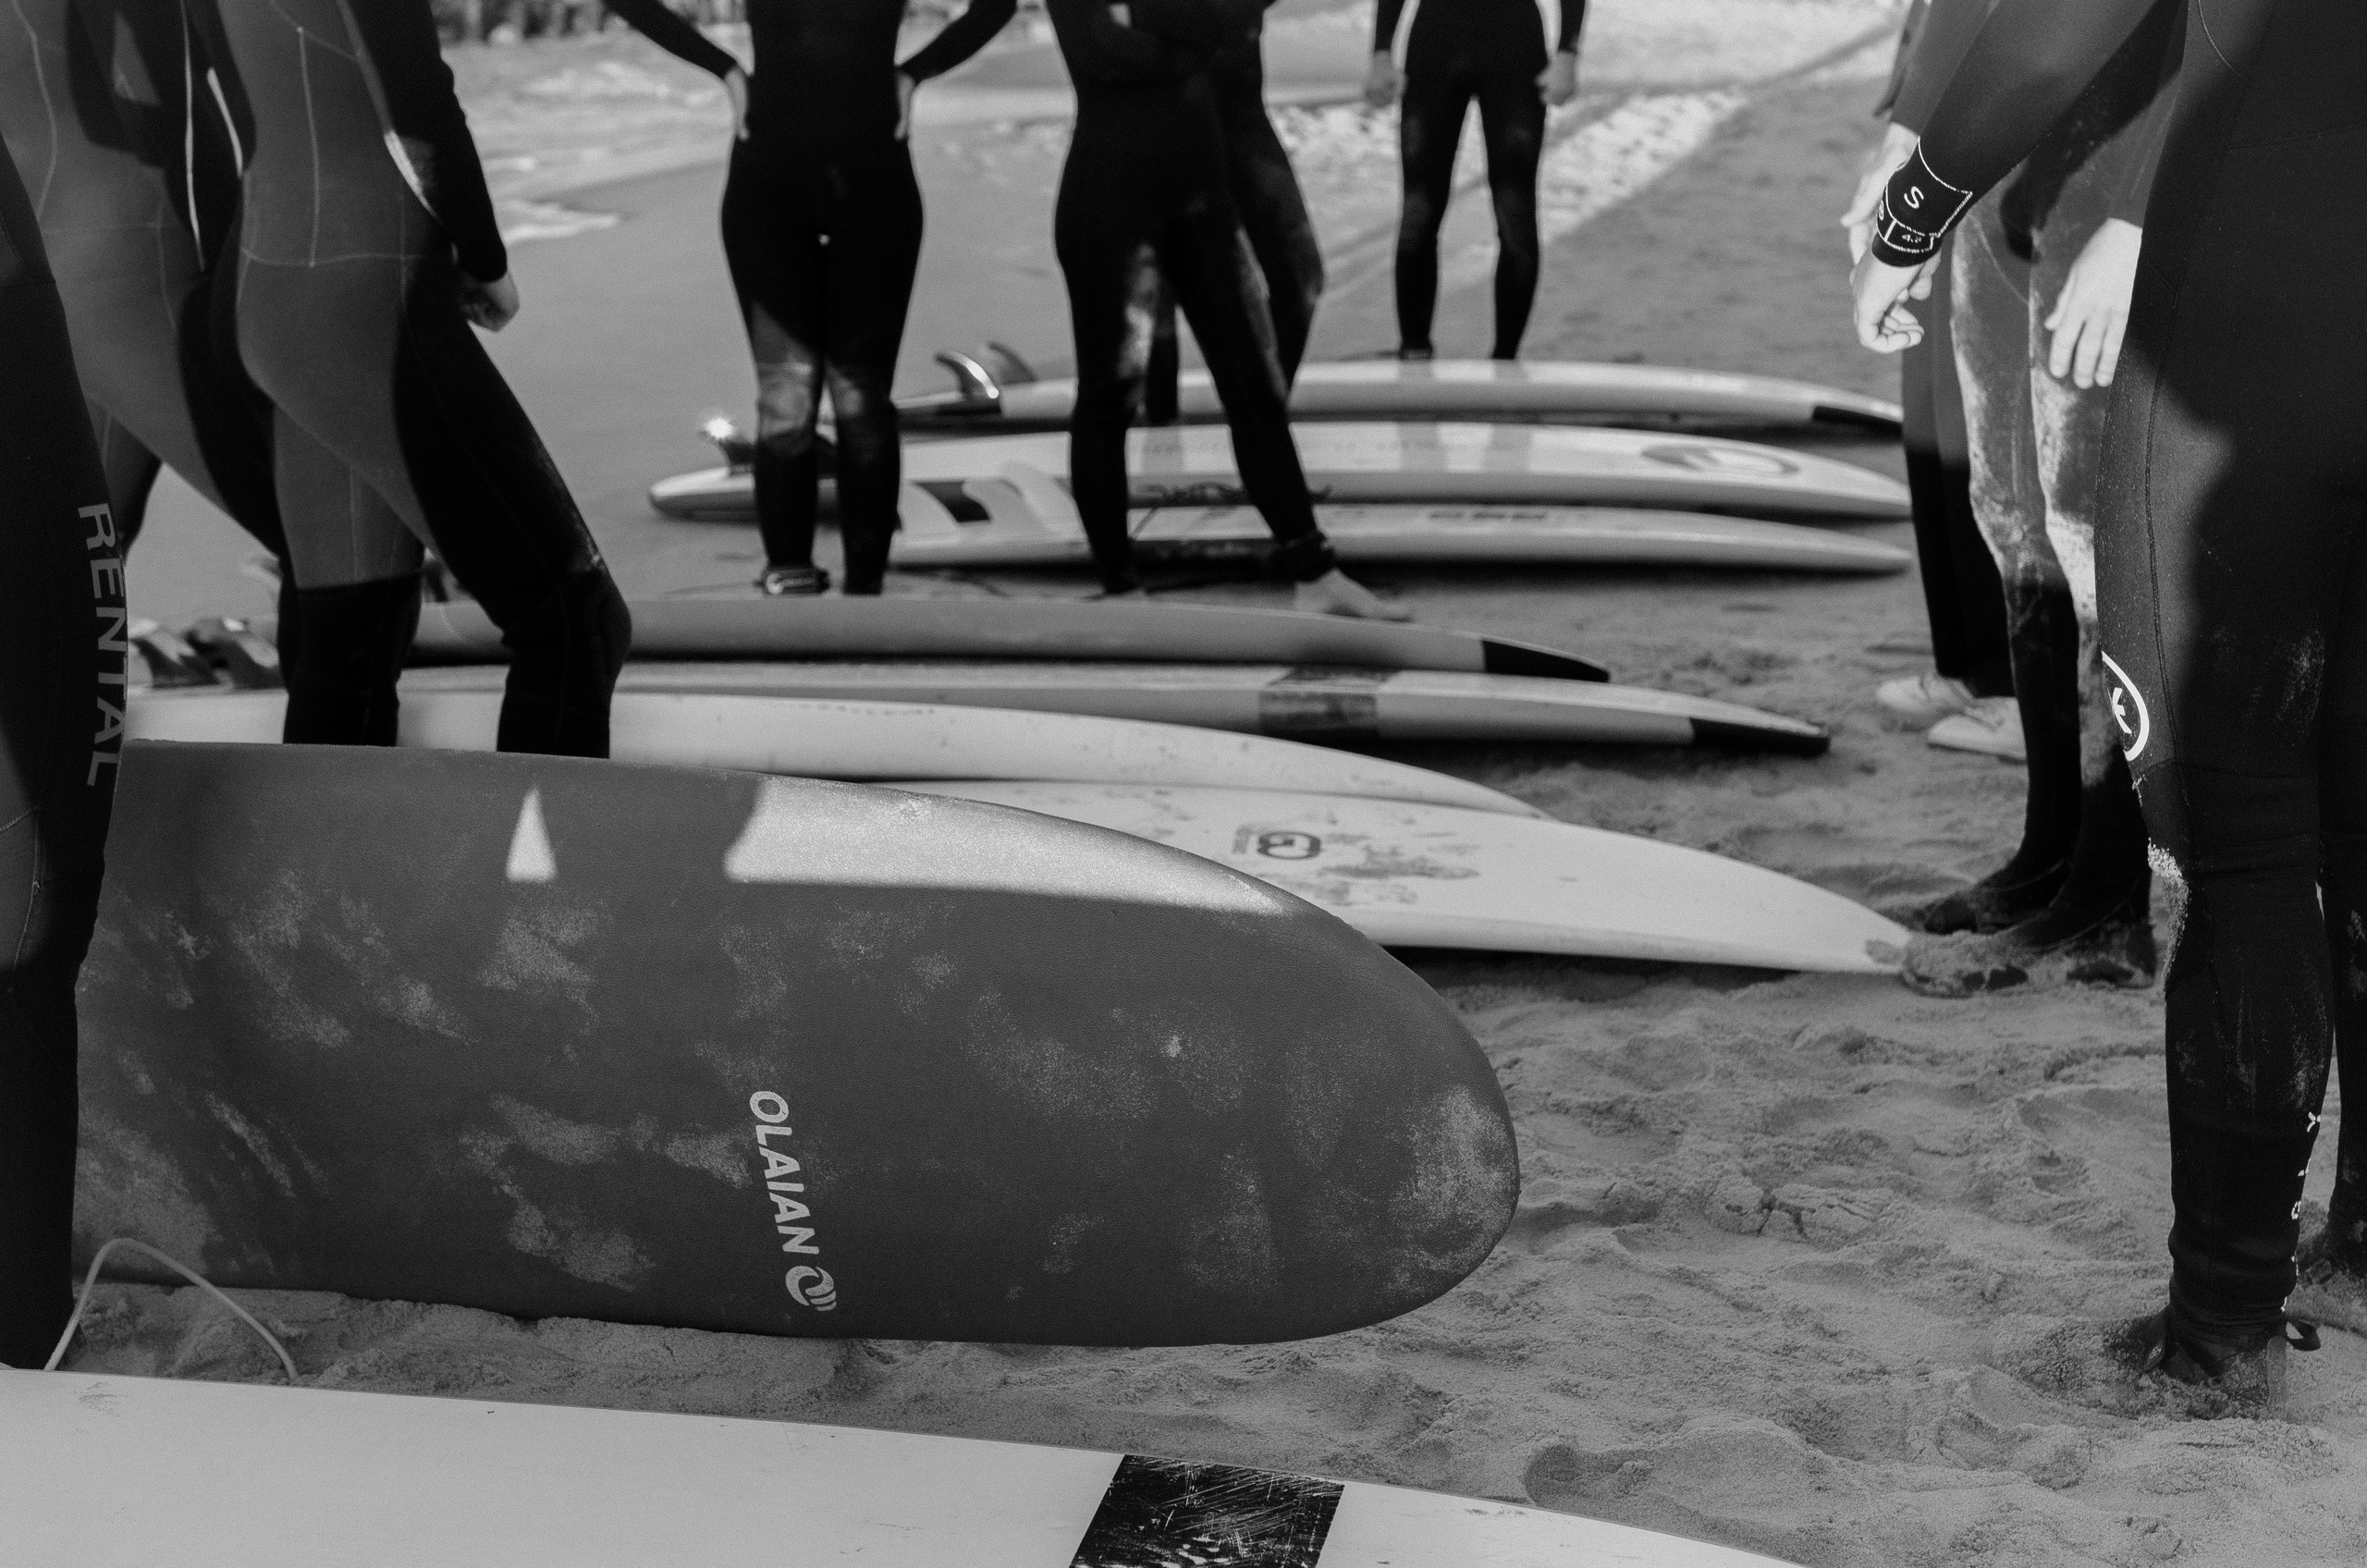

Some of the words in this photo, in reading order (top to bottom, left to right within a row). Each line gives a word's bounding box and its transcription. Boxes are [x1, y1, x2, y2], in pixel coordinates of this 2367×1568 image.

[1903, 185, 1925, 209] S
[77, 502, 129, 788] RENTAL
[749, 1090, 820, 1255] OLAIAN
